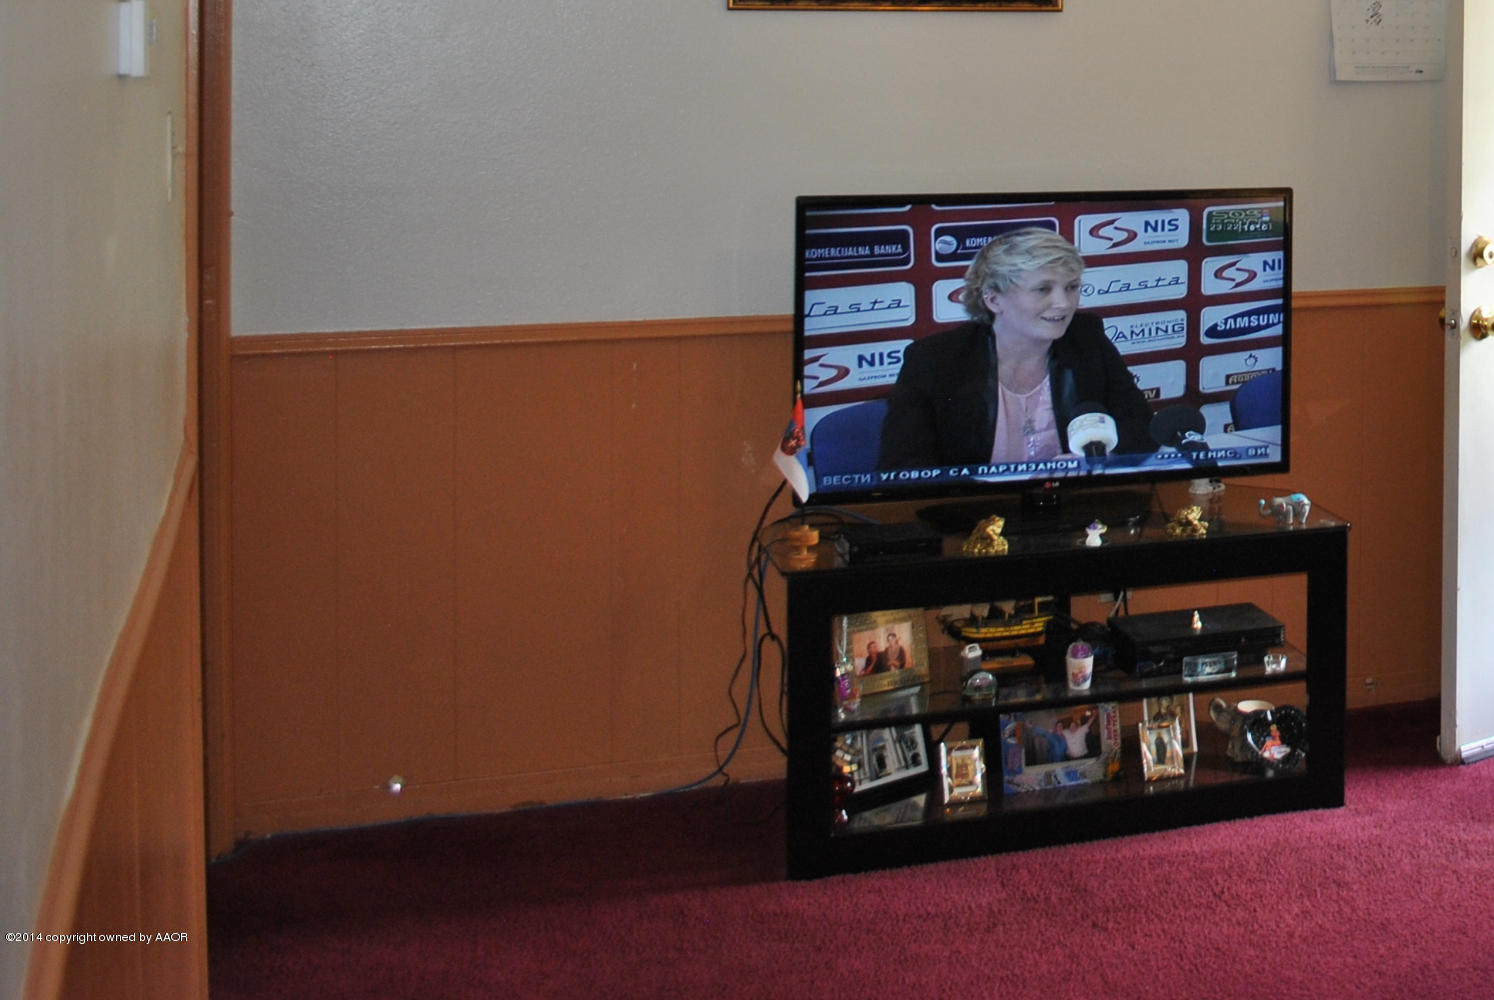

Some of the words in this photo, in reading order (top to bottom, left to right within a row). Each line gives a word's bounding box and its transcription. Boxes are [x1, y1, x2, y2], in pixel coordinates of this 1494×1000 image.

[1144, 218, 1179, 233] NIS
[805, 245, 871, 259] KOMERCIJALNA
[874, 244, 903, 255] BANKA
[857, 350, 902, 368] NIS
[823, 473, 872, 486] ВЕСТИ
[880, 469, 941, 481] УГОВОР
[949, 467, 970, 476] СА
[978, 460, 1078, 474] ПАРТИЗАНОМ
